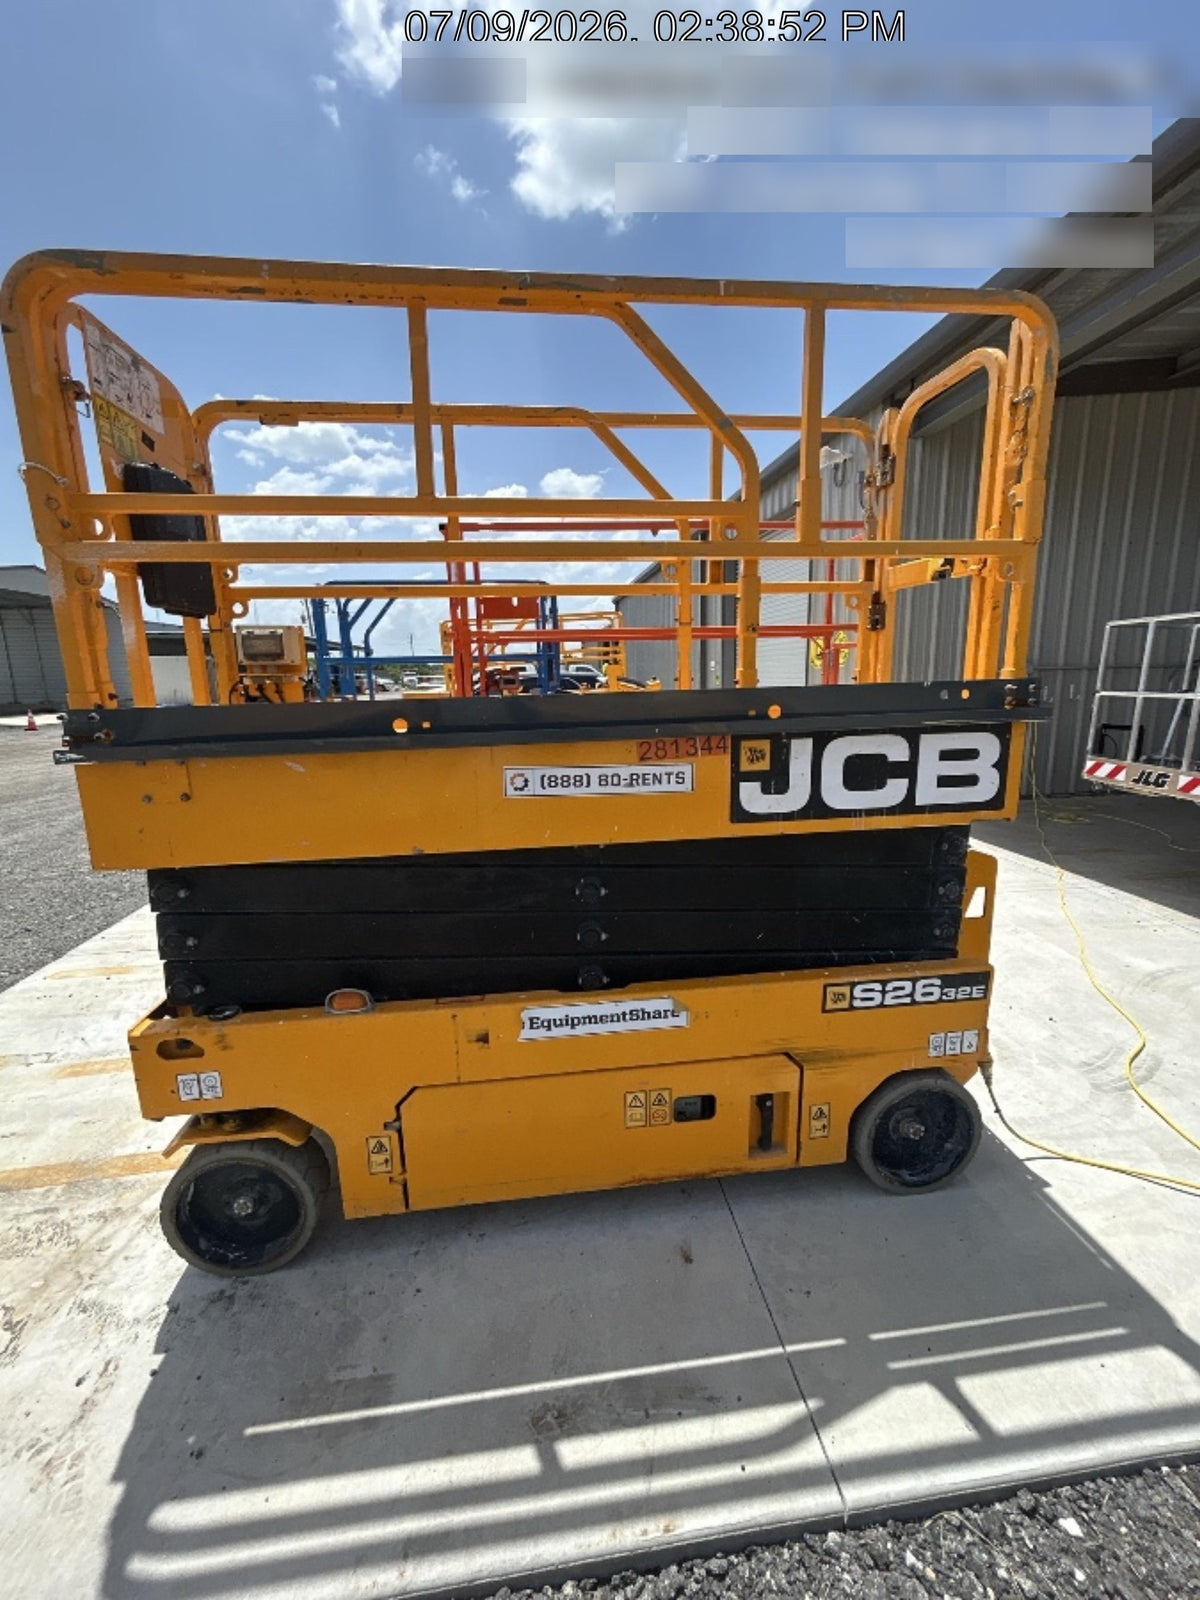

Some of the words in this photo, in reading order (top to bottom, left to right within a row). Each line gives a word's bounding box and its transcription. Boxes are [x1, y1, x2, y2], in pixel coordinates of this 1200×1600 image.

[639, 736, 728, 760] 281344
[540, 773, 591, 790] (888)
[739, 732, 1000, 814] JCB
[1131, 769, 1171, 788] JLG
